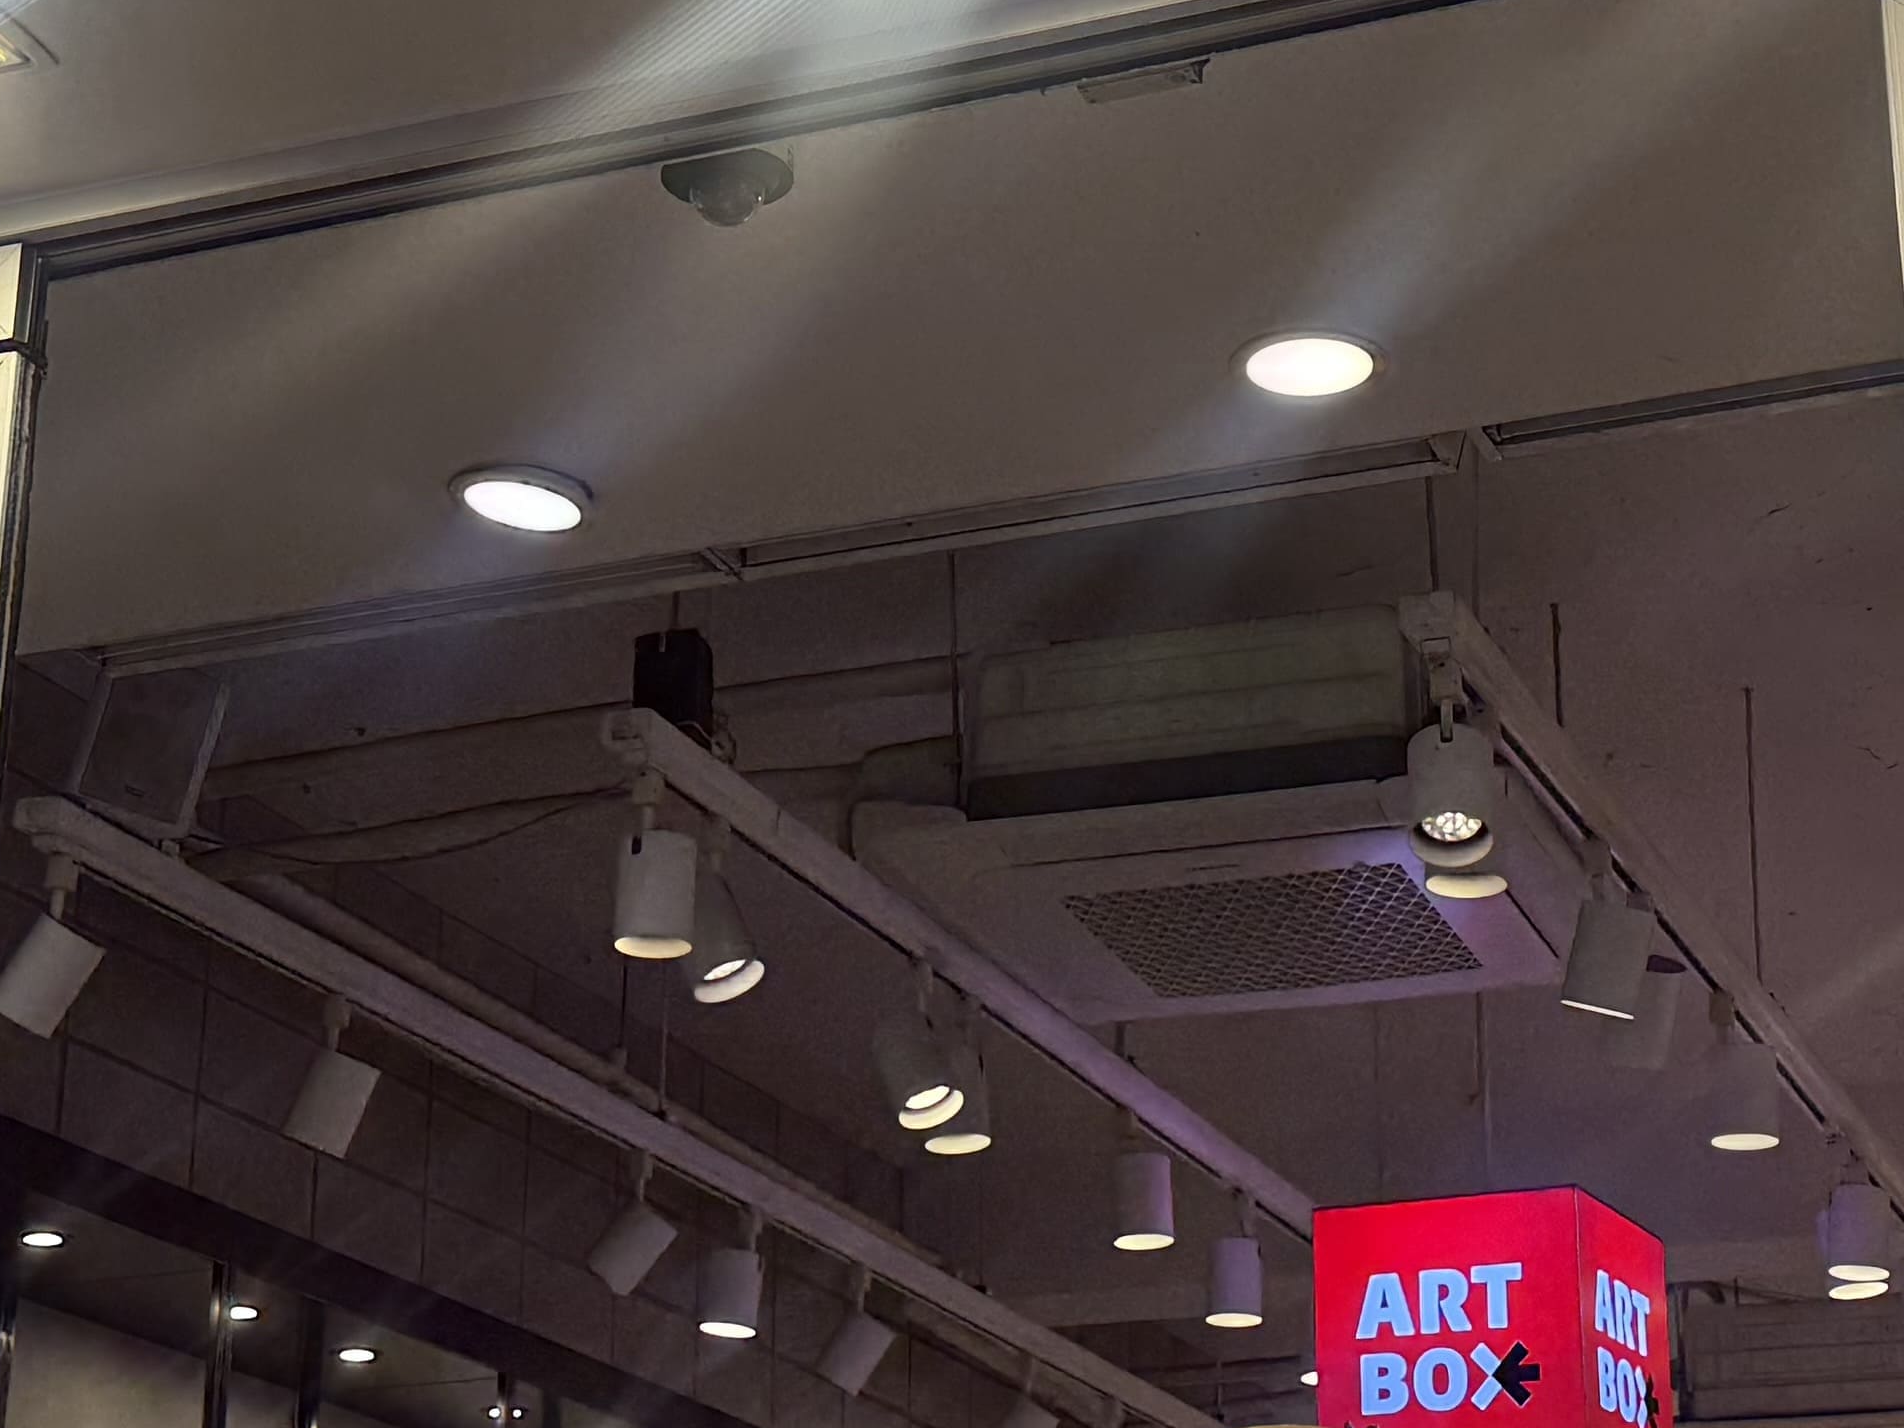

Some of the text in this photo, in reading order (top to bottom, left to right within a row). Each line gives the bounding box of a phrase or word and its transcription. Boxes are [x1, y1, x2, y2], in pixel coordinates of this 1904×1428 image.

[1356, 1262, 1522, 1340] ART
[1595, 1268, 1650, 1357] ART
[1360, 1340, 1541, 1416] BOX
